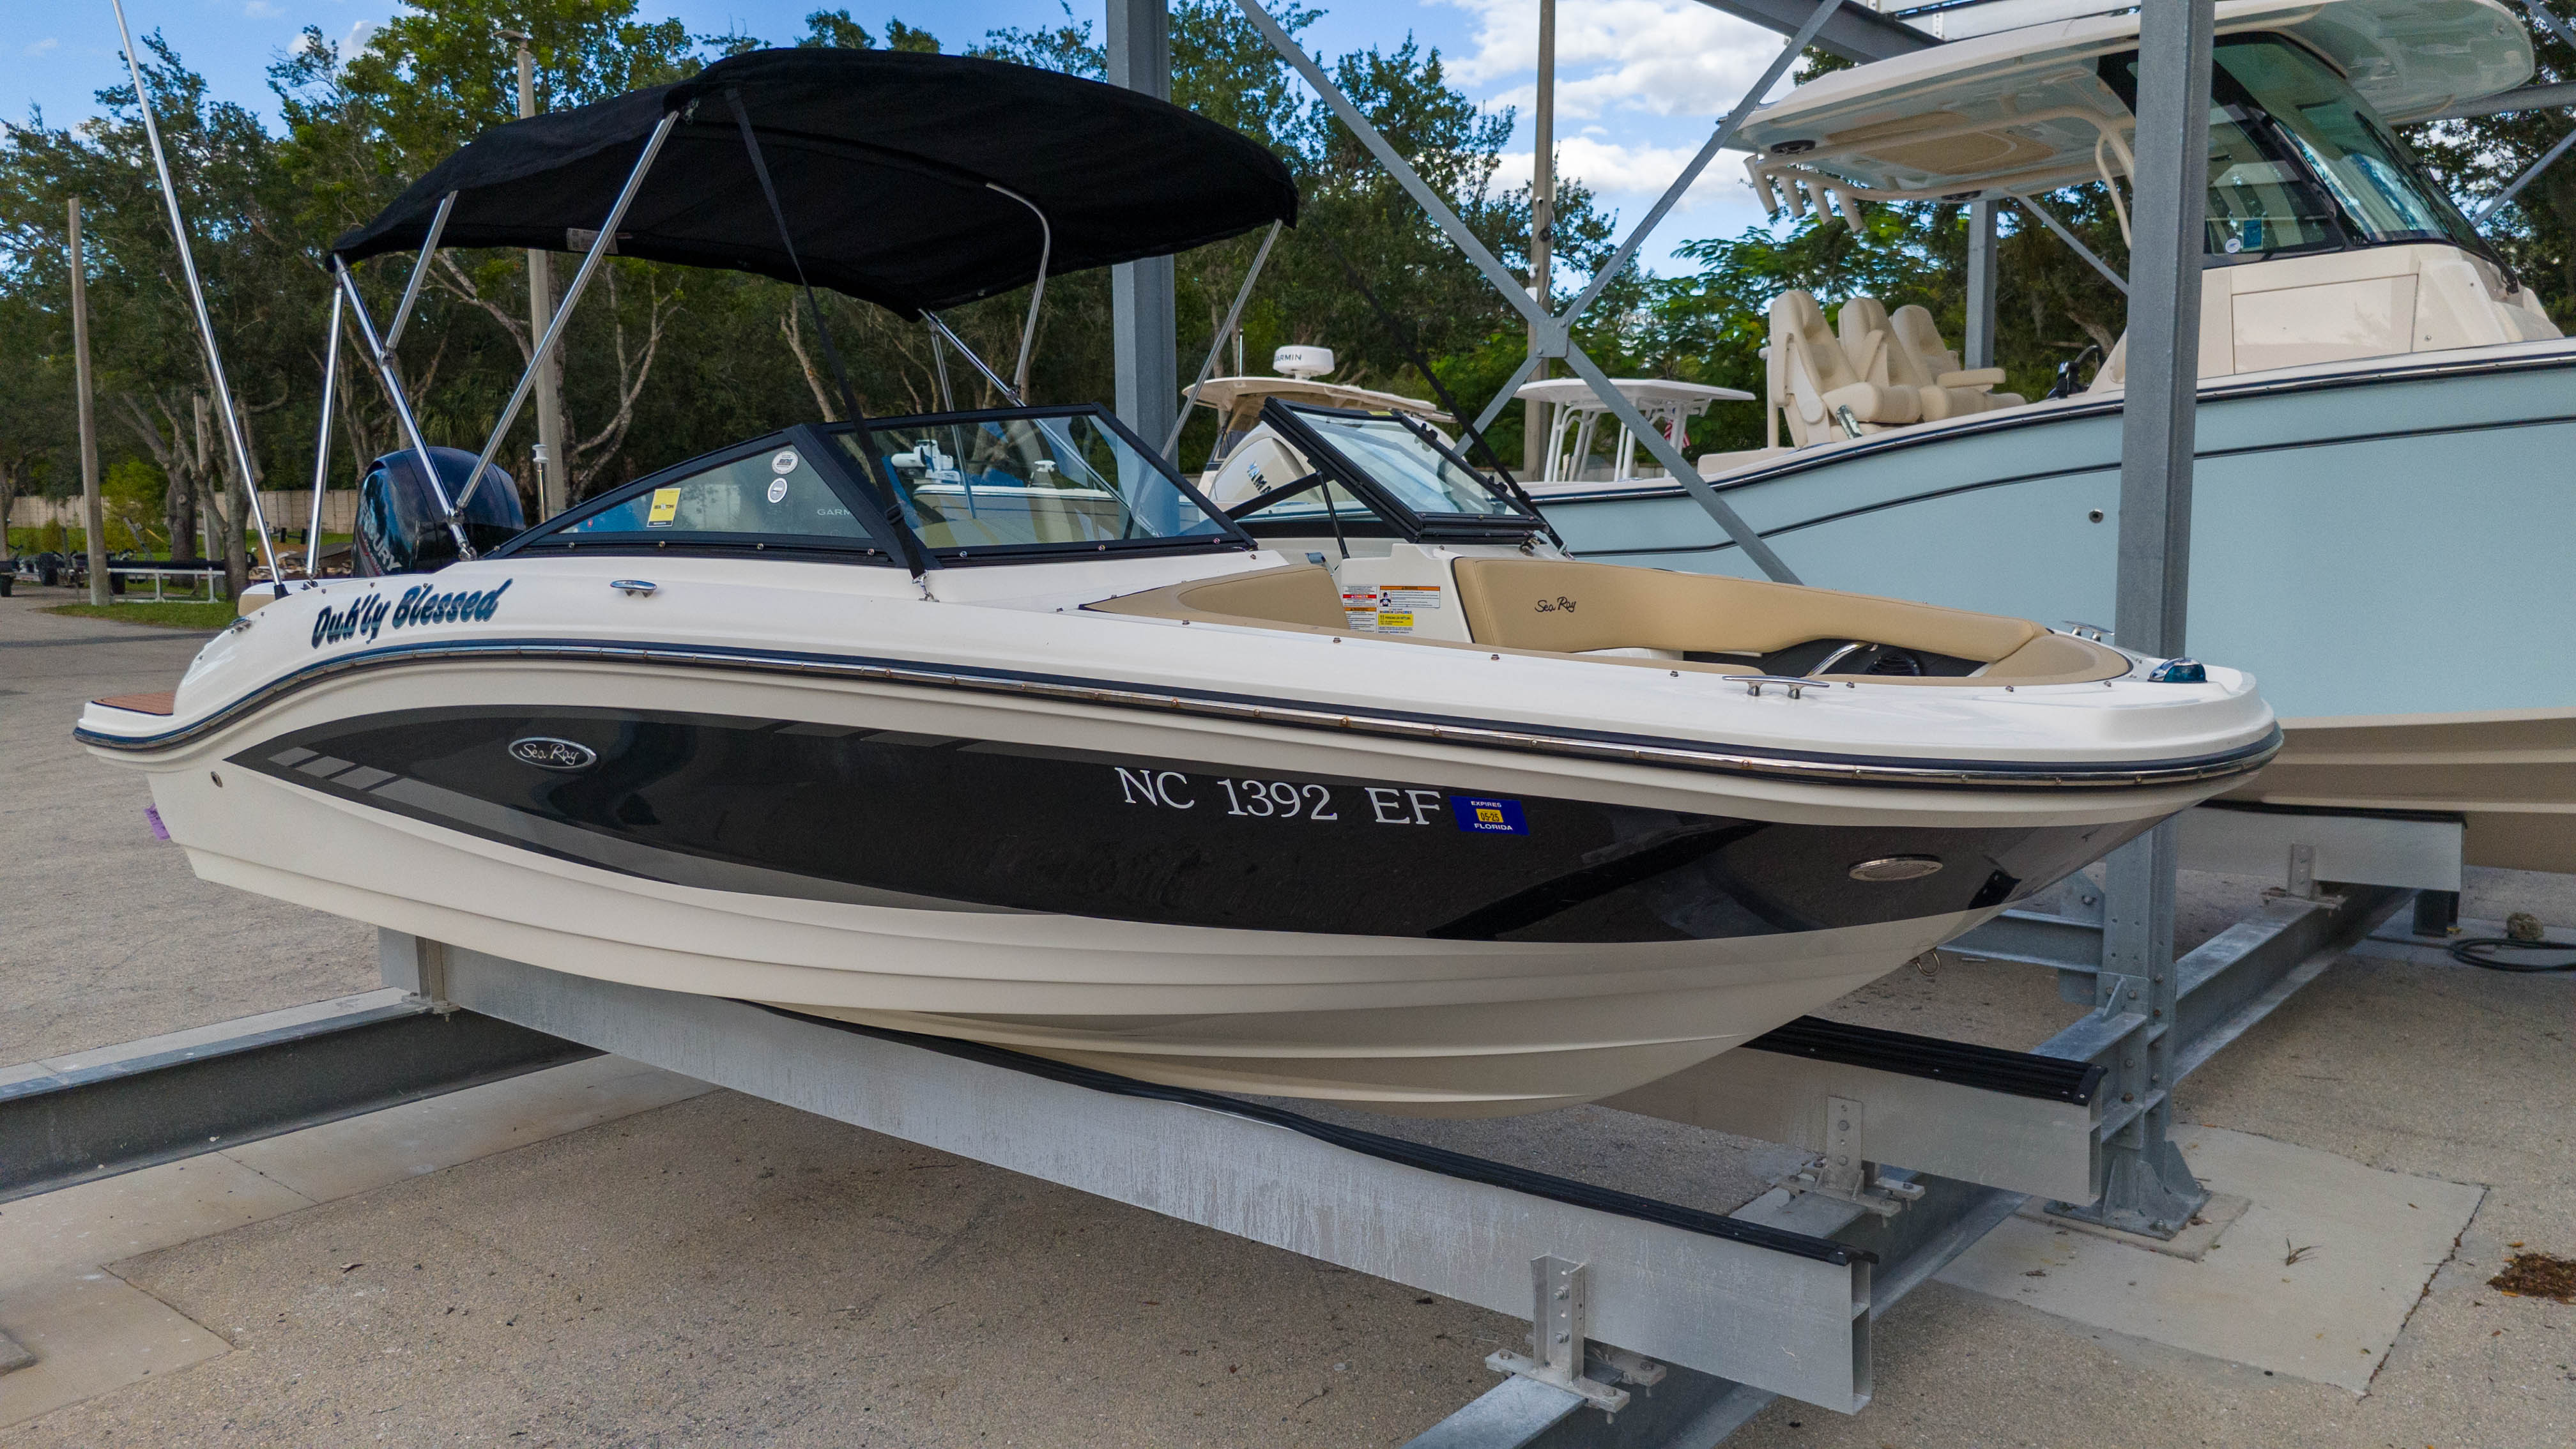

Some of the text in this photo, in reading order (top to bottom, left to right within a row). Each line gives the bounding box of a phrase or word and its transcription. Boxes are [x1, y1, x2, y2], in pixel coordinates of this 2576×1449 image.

[392, 578, 513, 629] Blessed
[1534, 596, 1577, 613] Sea Ray
[519, 742, 579, 765] Sea Ray
[1115, 767, 1441, 824] NC 1392 EF
[1480, 813, 1499, 822] 05-25
